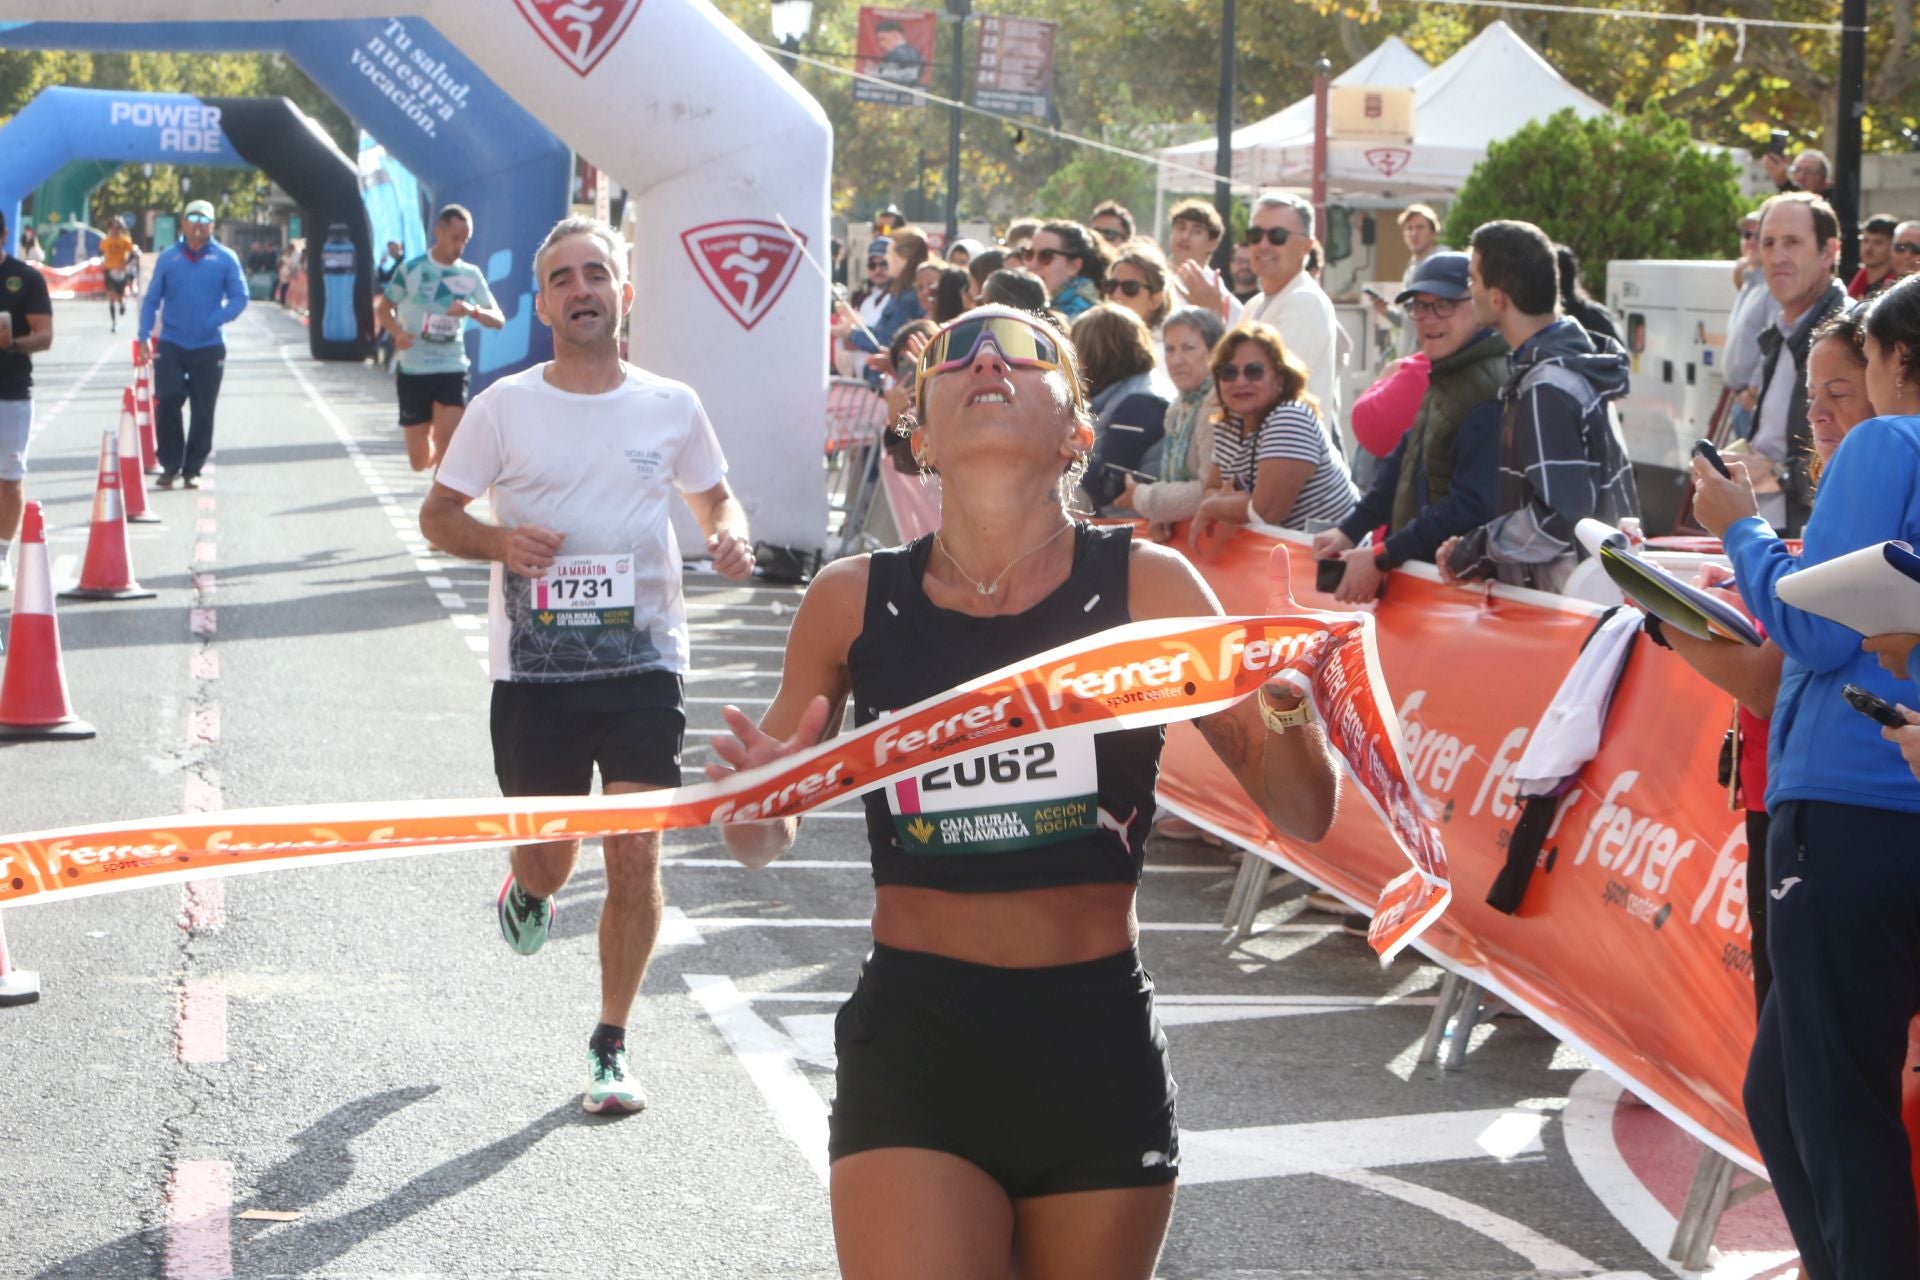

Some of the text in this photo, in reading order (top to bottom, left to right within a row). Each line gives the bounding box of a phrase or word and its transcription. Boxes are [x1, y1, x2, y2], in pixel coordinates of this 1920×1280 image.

[384, 16, 470, 109] Tu salud,
[366, 36, 454, 122] nuestra
[346, 47, 437, 138] vocación.
[111, 101, 222, 129] POWER
[160, 128, 221, 152] ADE
[558, 564, 607, 576] LA MARATÓN
[551, 578, 613, 599] 1731
[921, 742, 1057, 792] 2062
[1034, 802, 1087, 820] ACCIÓN
[940, 812, 1023, 833] CAJA RURAL
[1035, 817, 1085, 836] SOCIAL
[942, 825, 1030, 845] DE NAVARRA
